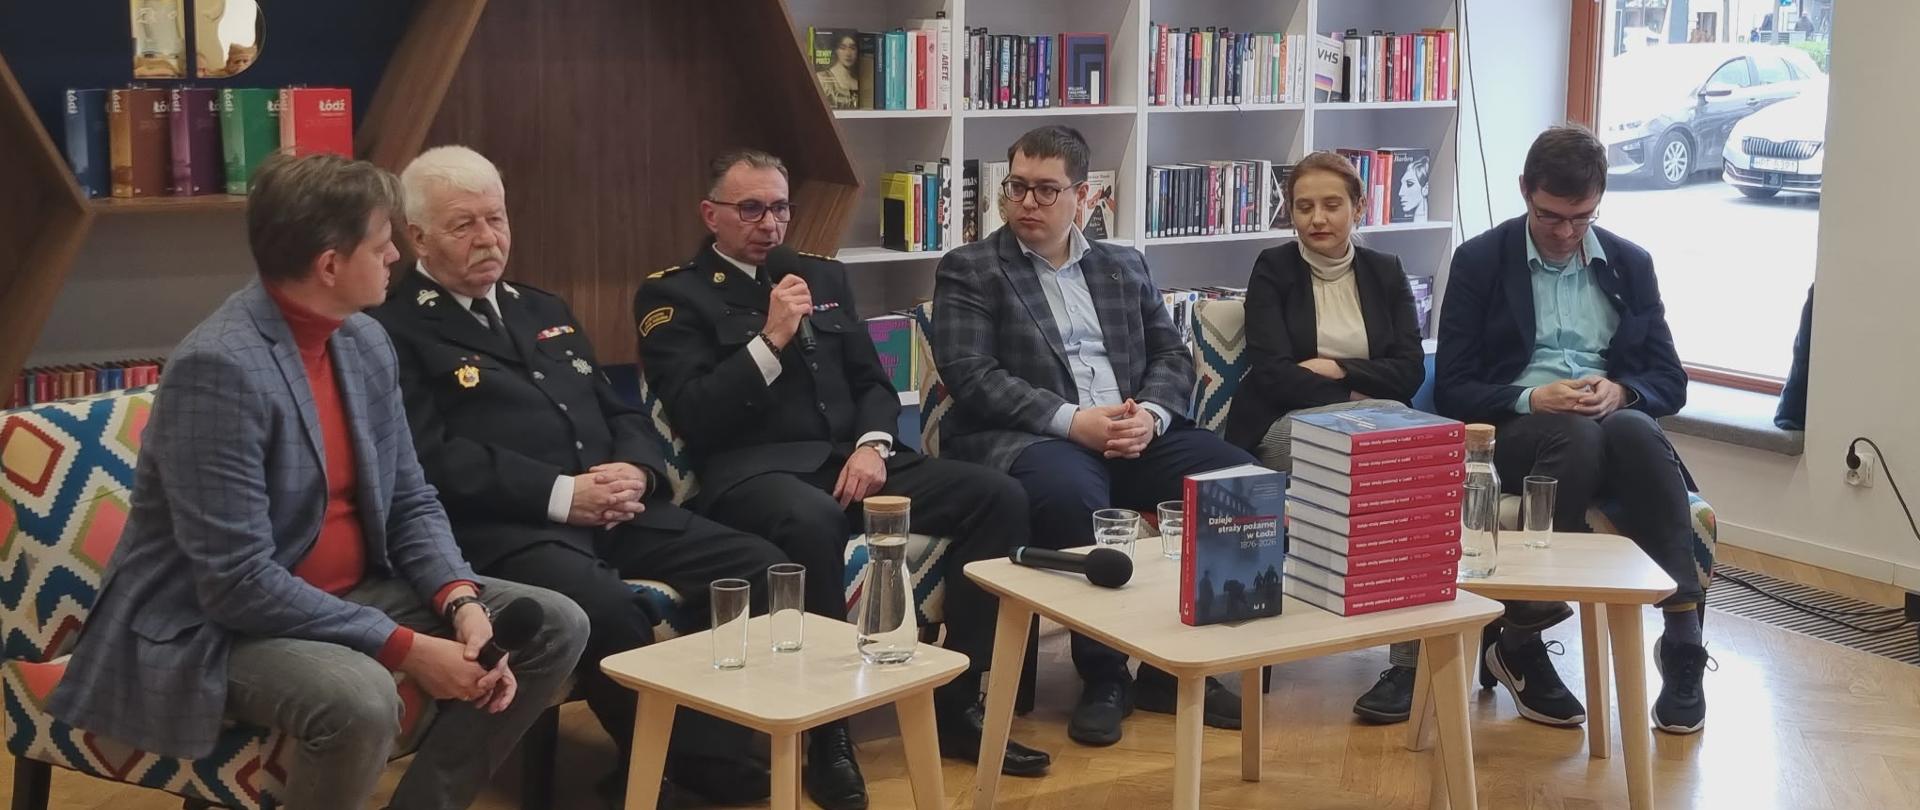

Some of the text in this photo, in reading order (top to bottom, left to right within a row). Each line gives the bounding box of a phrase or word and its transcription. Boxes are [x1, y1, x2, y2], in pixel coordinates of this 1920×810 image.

[1317, 47, 1339, 64] VHS
[153, 98, 171, 113] Łó
[266, 98, 280, 112] Łó
[319, 99, 345, 112] Łódź
[1208, 514, 1233, 526] Dzieje
[1218, 519, 1277, 534] straży pożarnej
[1255, 528, 1277, 538] Łodzi
